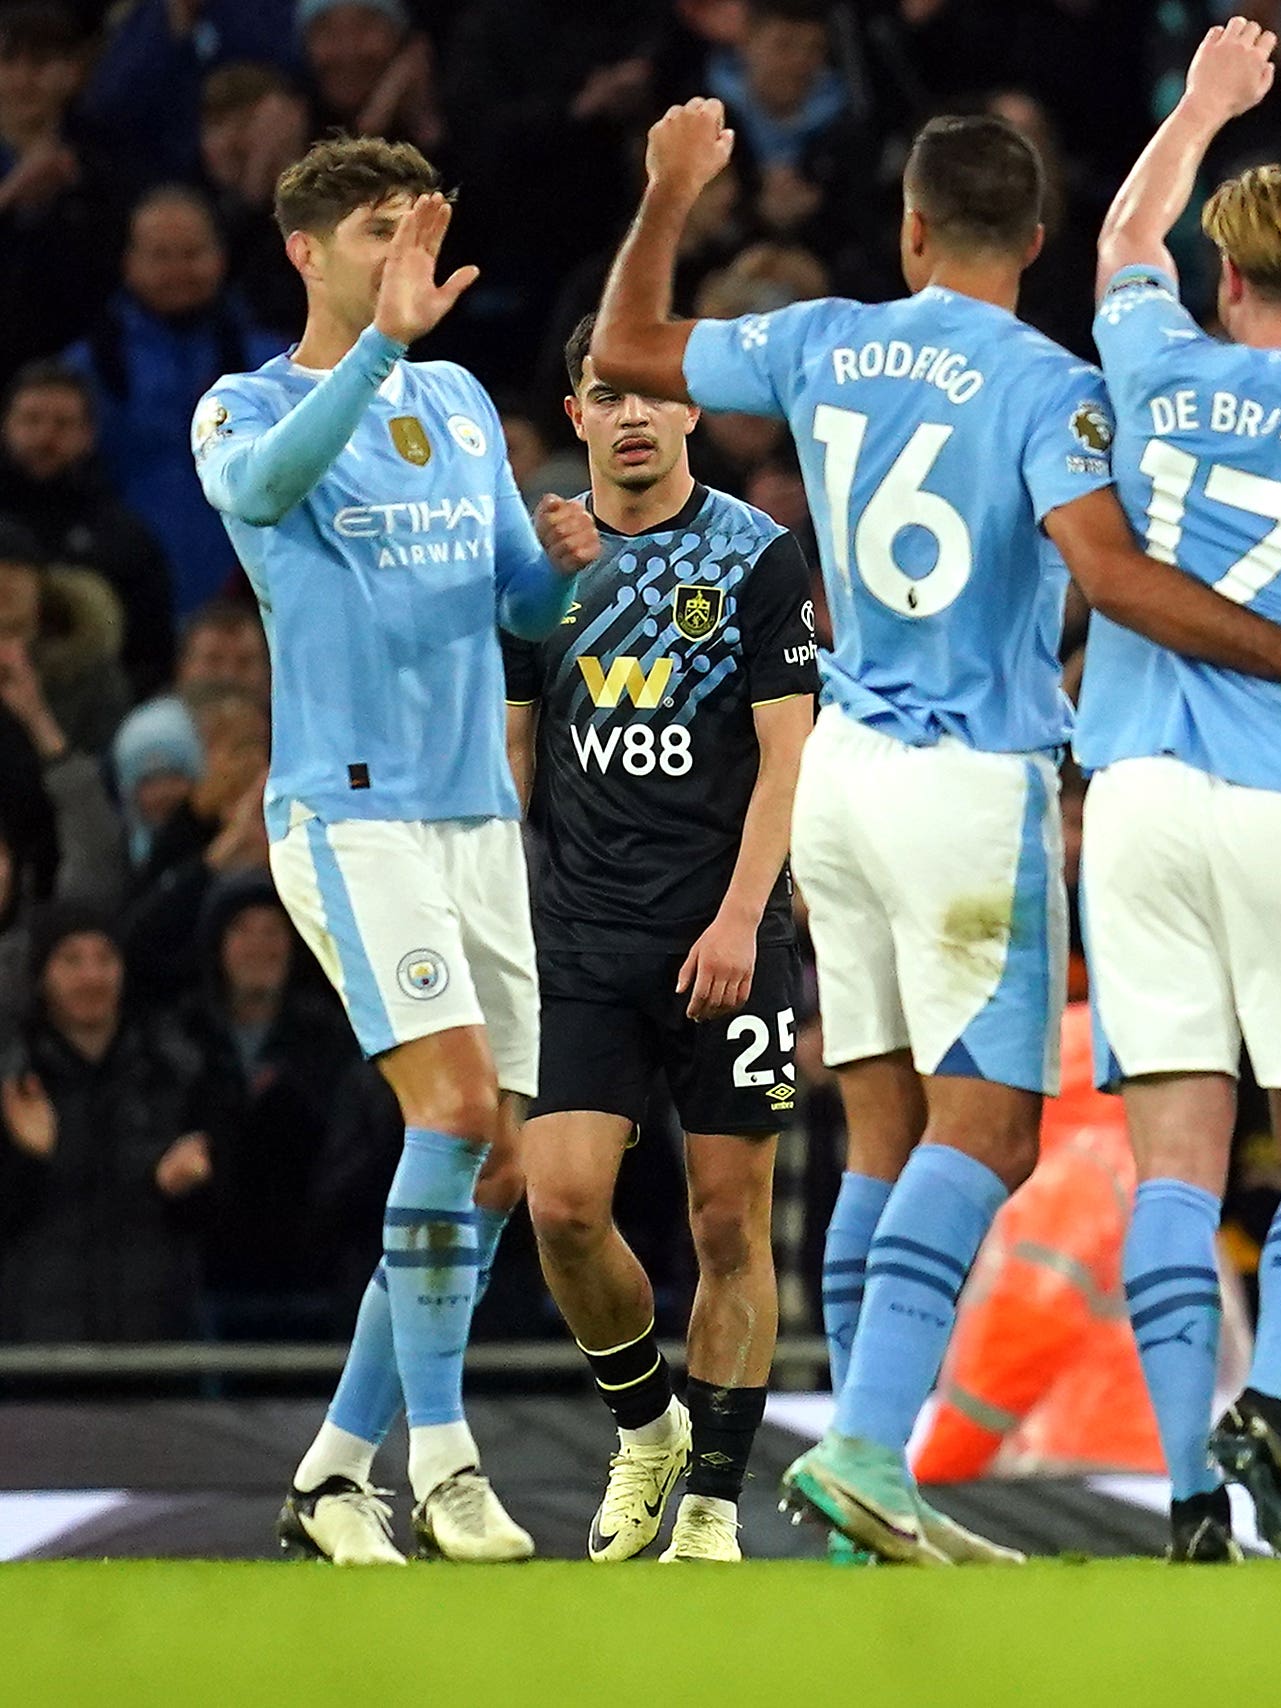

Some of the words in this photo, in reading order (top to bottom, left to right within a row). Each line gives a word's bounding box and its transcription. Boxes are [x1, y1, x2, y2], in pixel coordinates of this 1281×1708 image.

[832, 340, 985, 405] RODRIGO
[1149, 389, 1200, 436] DE
[812, 403, 973, 619] 16
[569, 722, 694, 777] W88
[726, 1006, 796, 1088] 25
